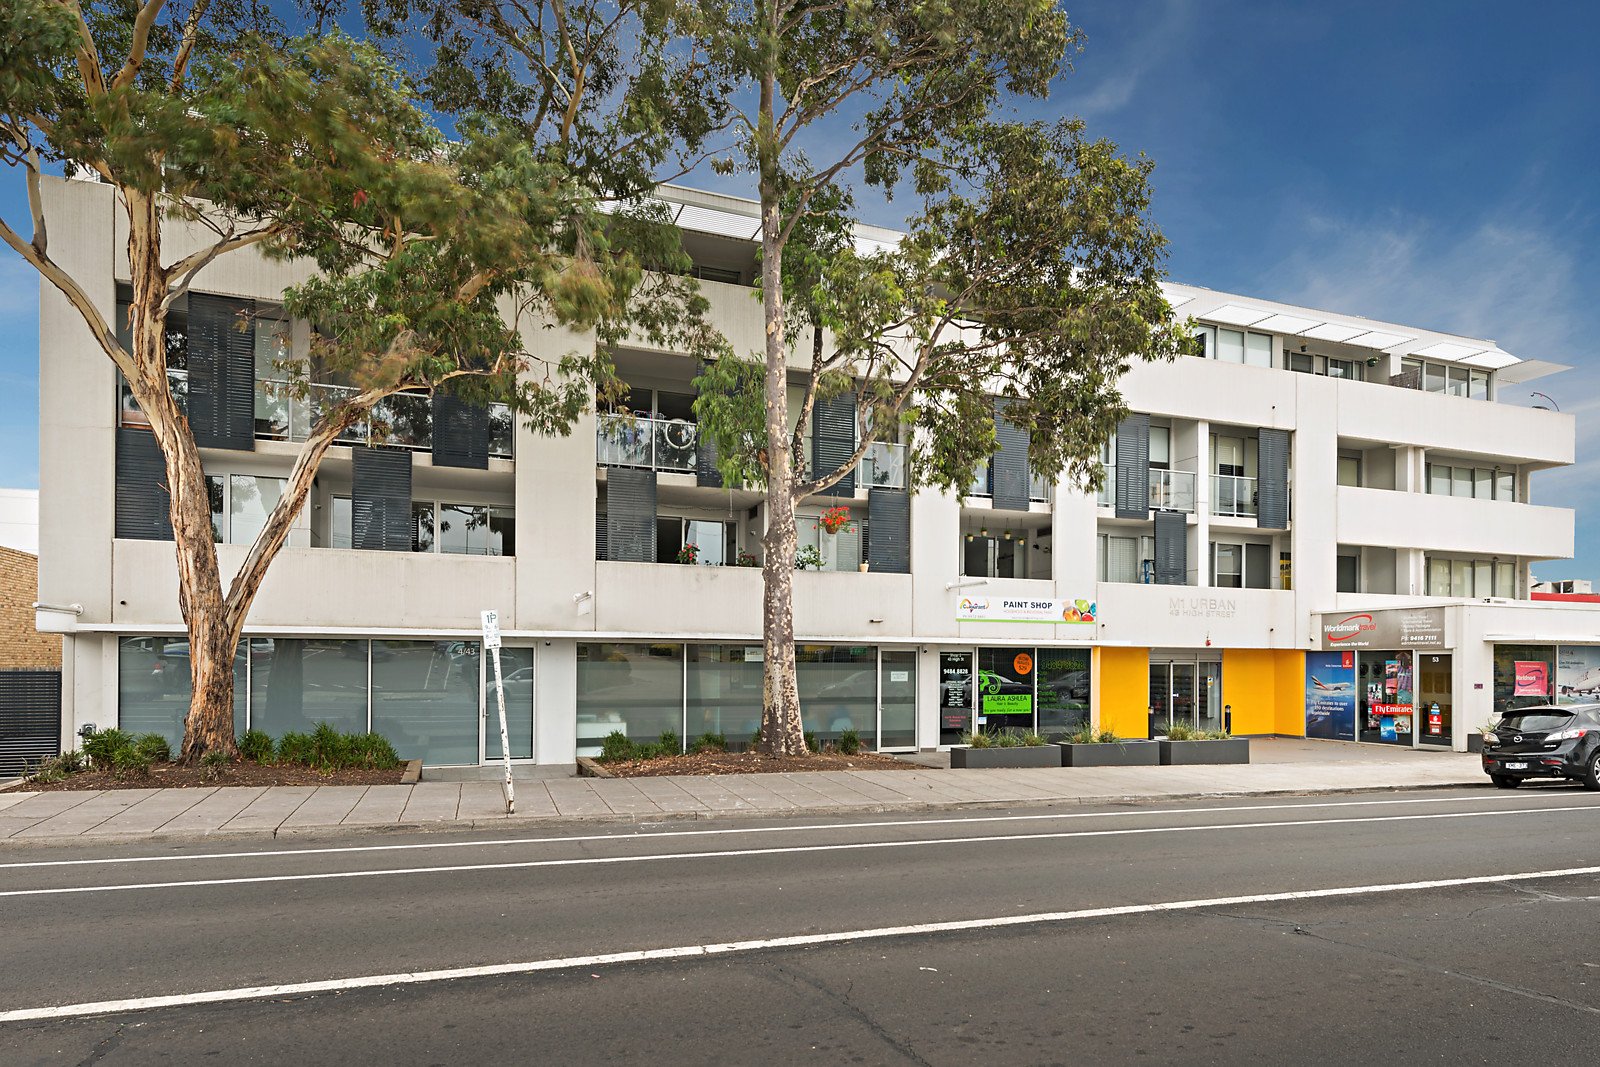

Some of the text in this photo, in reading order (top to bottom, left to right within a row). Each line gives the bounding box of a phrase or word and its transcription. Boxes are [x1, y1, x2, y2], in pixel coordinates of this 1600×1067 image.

[1003, 601, 1053, 610] PAINT SHOP
[1190, 598, 1236, 610] URBAN
[1169, 609, 1180, 617] 43
[486, 613, 497, 623] 1P
[1376, 705, 1413, 713] Fly Emirates
